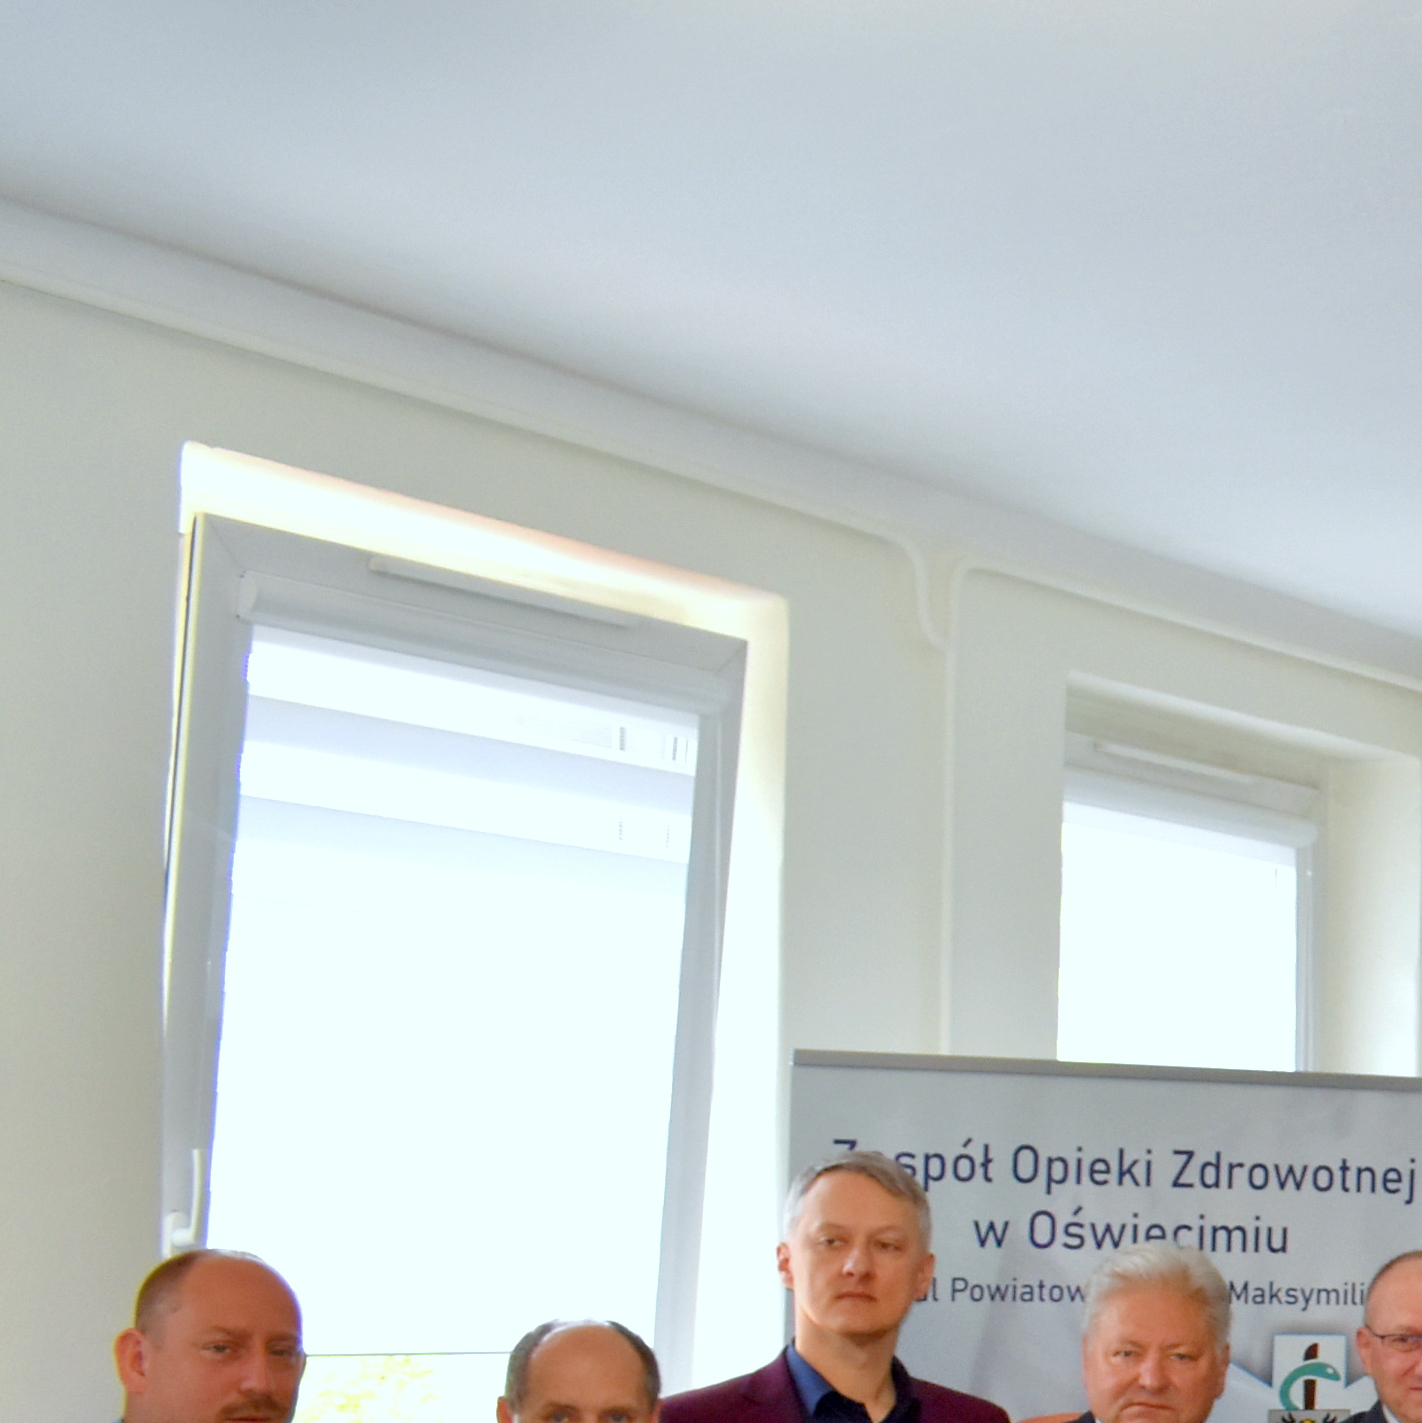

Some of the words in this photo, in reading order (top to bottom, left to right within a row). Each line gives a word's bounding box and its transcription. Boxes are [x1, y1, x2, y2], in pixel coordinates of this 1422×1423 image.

[833, 1137, 993, 1193] spół
[1012, 1144, 1152, 1195] Opieki
[1171, 1149, 1417, 1205] Zdrowotnej
[973, 1219, 1010, 1248] w
[951, 1277, 1086, 1303] Powiatow
[1228, 1280, 1367, 1311] Maksymili
